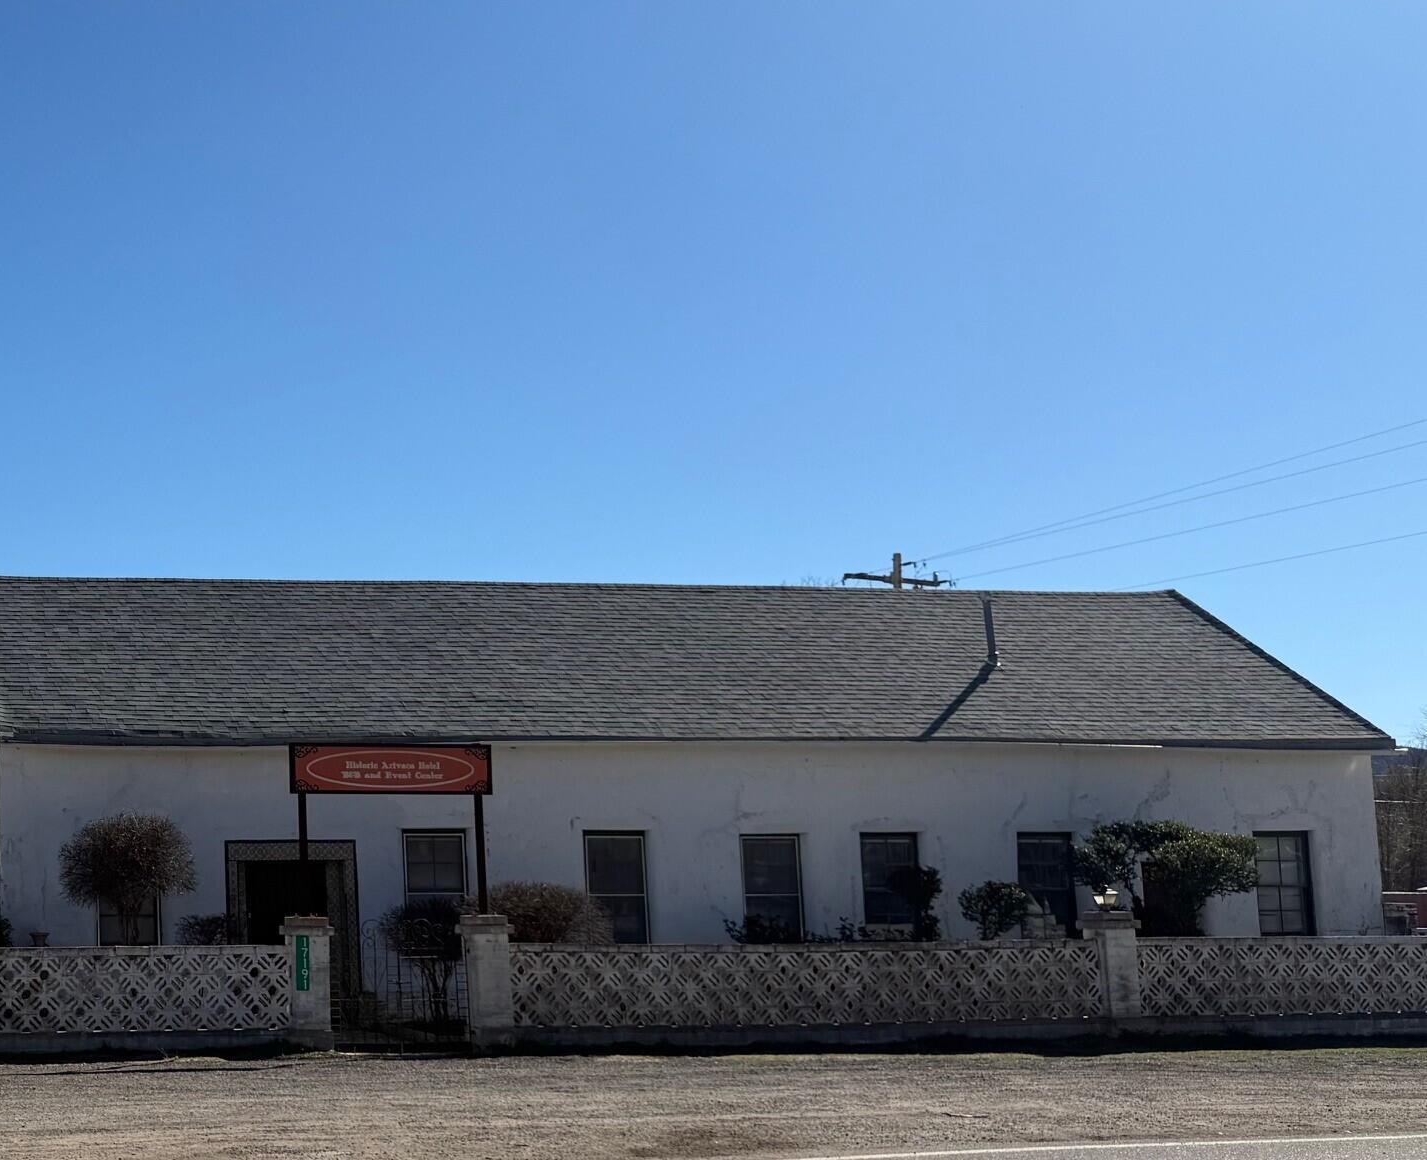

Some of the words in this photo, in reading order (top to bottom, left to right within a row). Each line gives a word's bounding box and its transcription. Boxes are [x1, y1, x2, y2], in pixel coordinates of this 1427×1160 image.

[345, 760, 379, 769] Historic
[418, 761, 441, 770] Hotel
[364, 771, 382, 779] and
[385, 771, 412, 779] Event
[415, 771, 444, 780] Center
[301, 937, 309, 990] 17191
